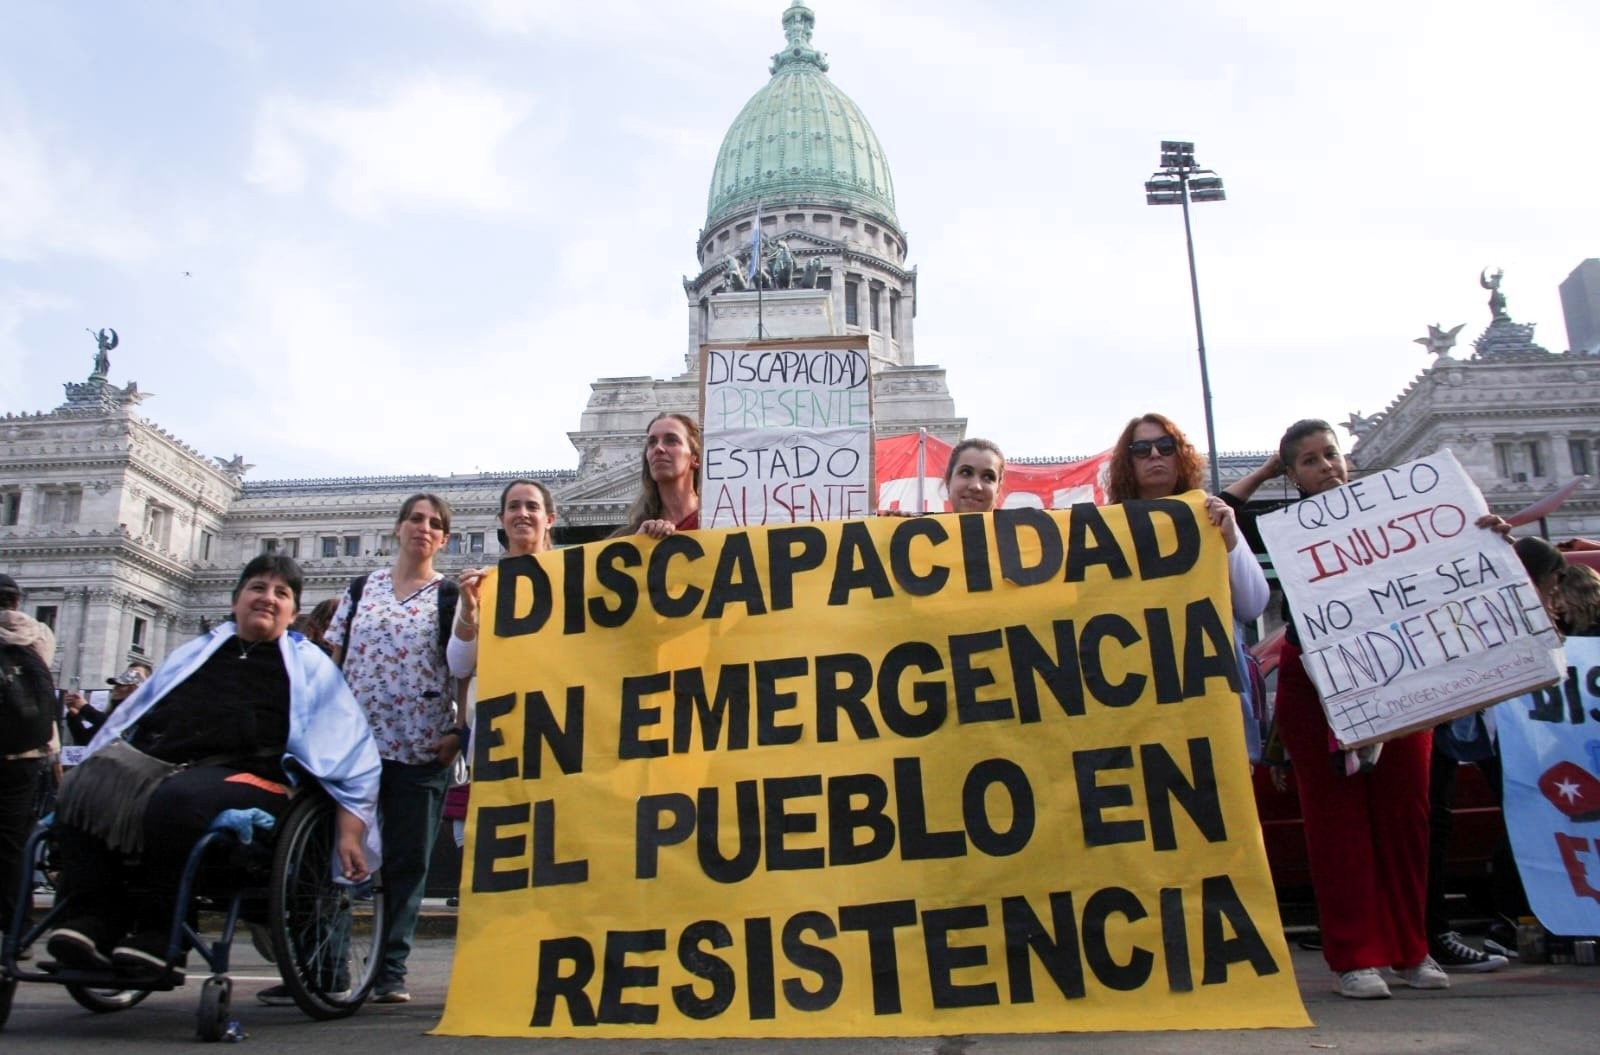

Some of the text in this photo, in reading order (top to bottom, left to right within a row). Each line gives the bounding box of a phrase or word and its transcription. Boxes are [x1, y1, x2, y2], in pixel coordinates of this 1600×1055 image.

[708, 350, 868, 389] DISCAPACIDAD
[712, 386, 869, 432] PRESENTE
[706, 445, 860, 480] ESTADO
[1297, 463, 1439, 530] QUE LO
[711, 482, 867, 529] AUSENTE
[1297, 504, 1466, 583] INJUSTO
[494, 498, 1200, 638] DISCAPACIDAD
[1303, 551, 1499, 640] NO ME SEA
[473, 597, 1243, 781] EN EMERGENCIA
[472, 737, 1227, 893] EL PUEBLO EN
[529, 874, 1280, 1028] RESISTENCIA
